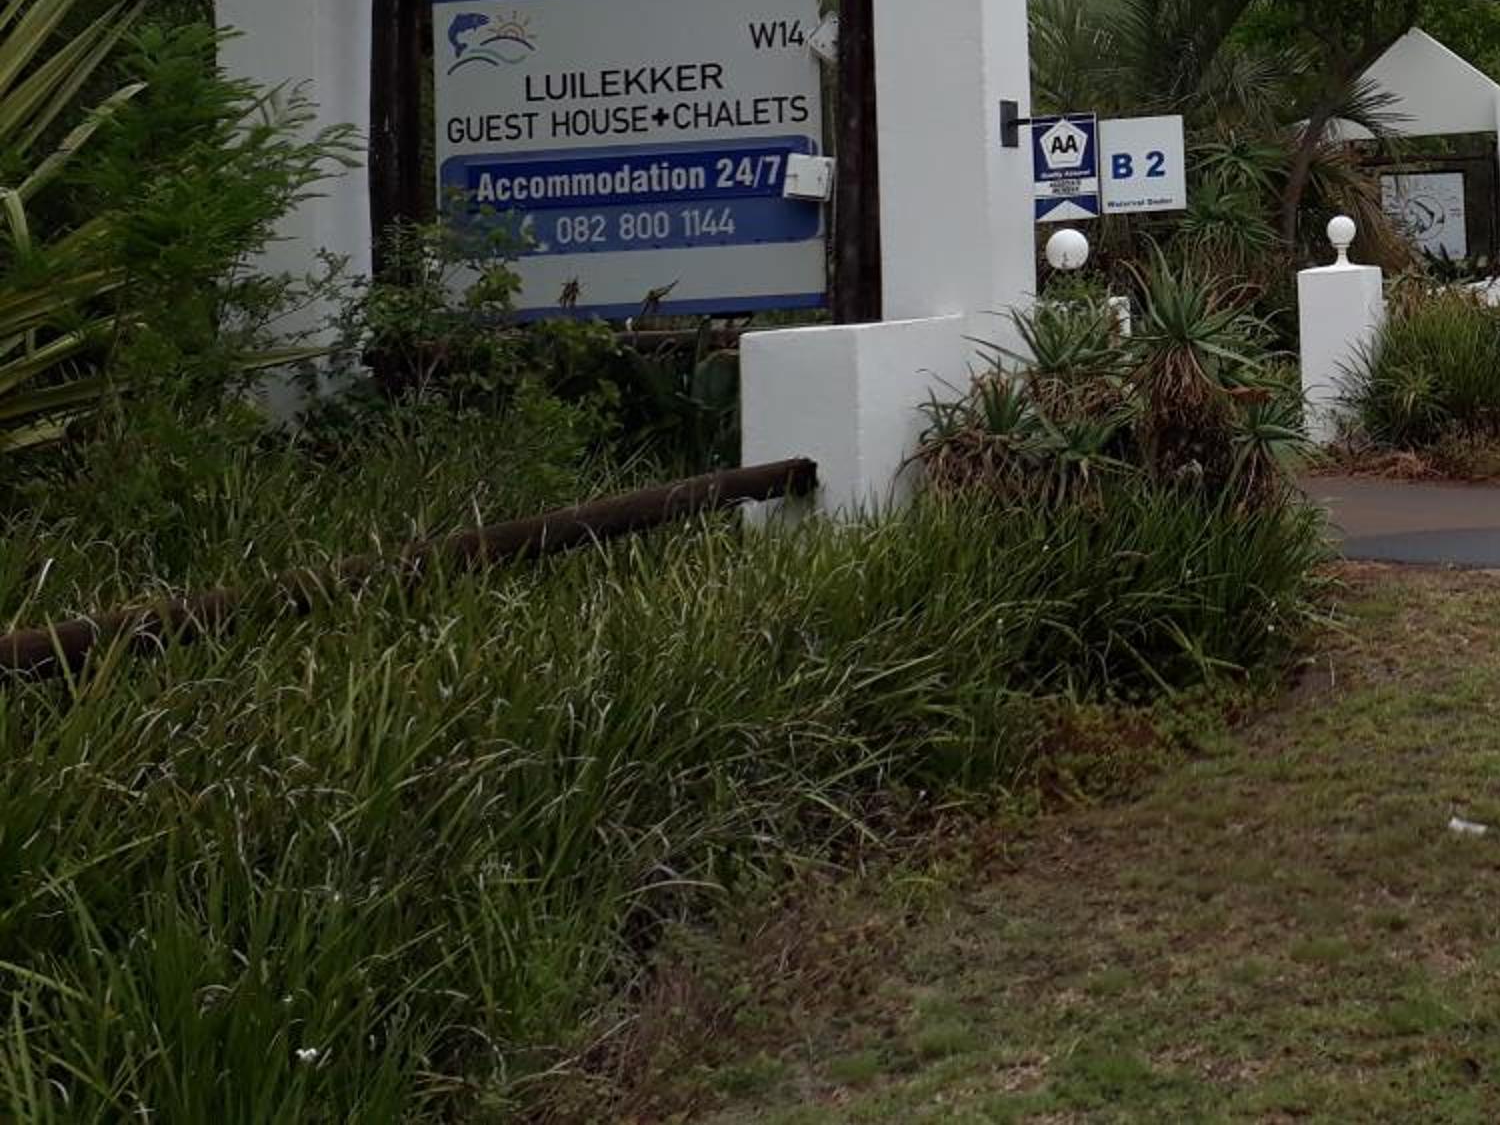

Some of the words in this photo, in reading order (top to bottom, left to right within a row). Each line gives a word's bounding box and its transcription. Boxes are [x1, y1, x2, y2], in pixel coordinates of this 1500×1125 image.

[748, 19, 805, 50] W14
[525, 63, 724, 103] LUILEKKER
[447, 112, 540, 144] GUEST
[1051, 134, 1079, 155] AA
[477, 163, 706, 203] Accommodation
[716, 154, 783, 190] 24/7
[1111, 152, 1134, 180] B
[1145, 150, 1166, 178] 2
[555, 215, 608, 245] 082
[618, 211, 670, 241] 800
[680, 207, 736, 237] 1144
